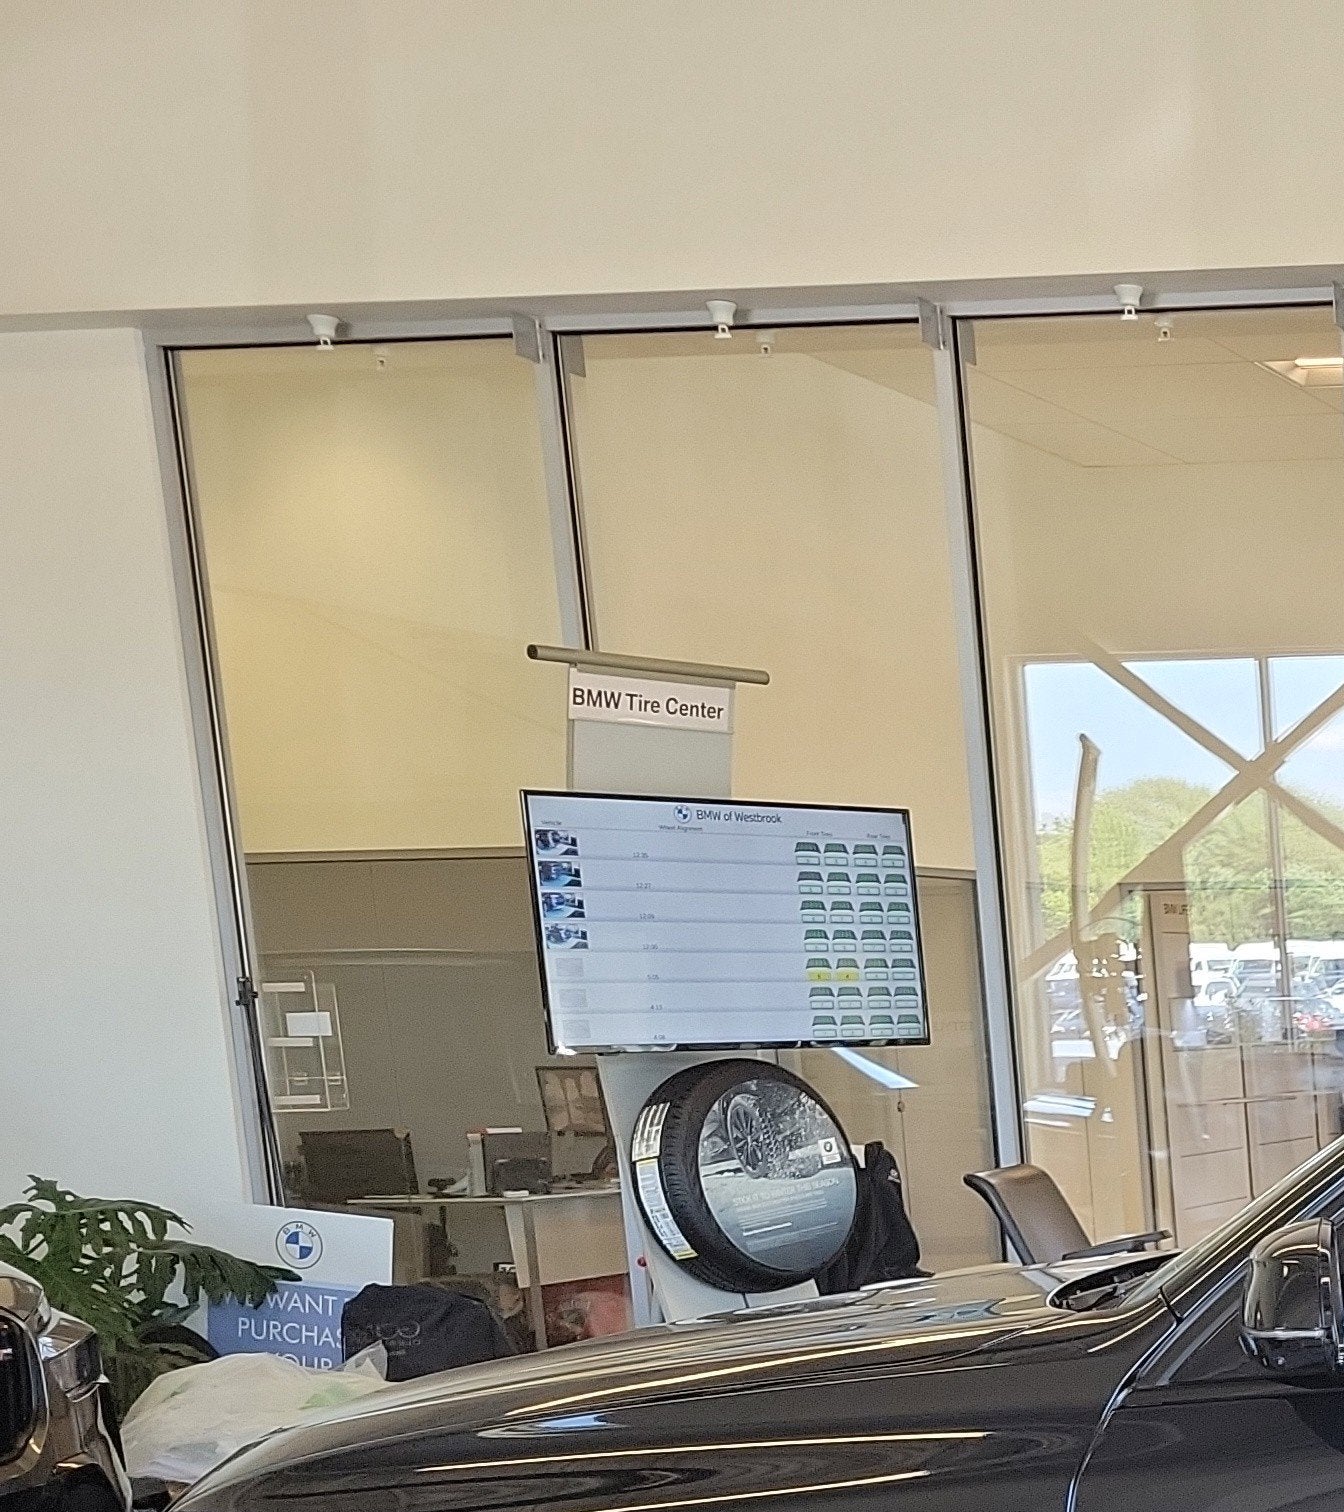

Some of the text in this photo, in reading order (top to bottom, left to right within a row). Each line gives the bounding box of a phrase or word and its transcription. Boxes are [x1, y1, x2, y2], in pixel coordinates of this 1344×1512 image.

[572, 687, 724, 720] BMW Tire Center
[696, 809, 782, 824] BMW of Westbrook
[266, 1291, 338, 1316] WANT
